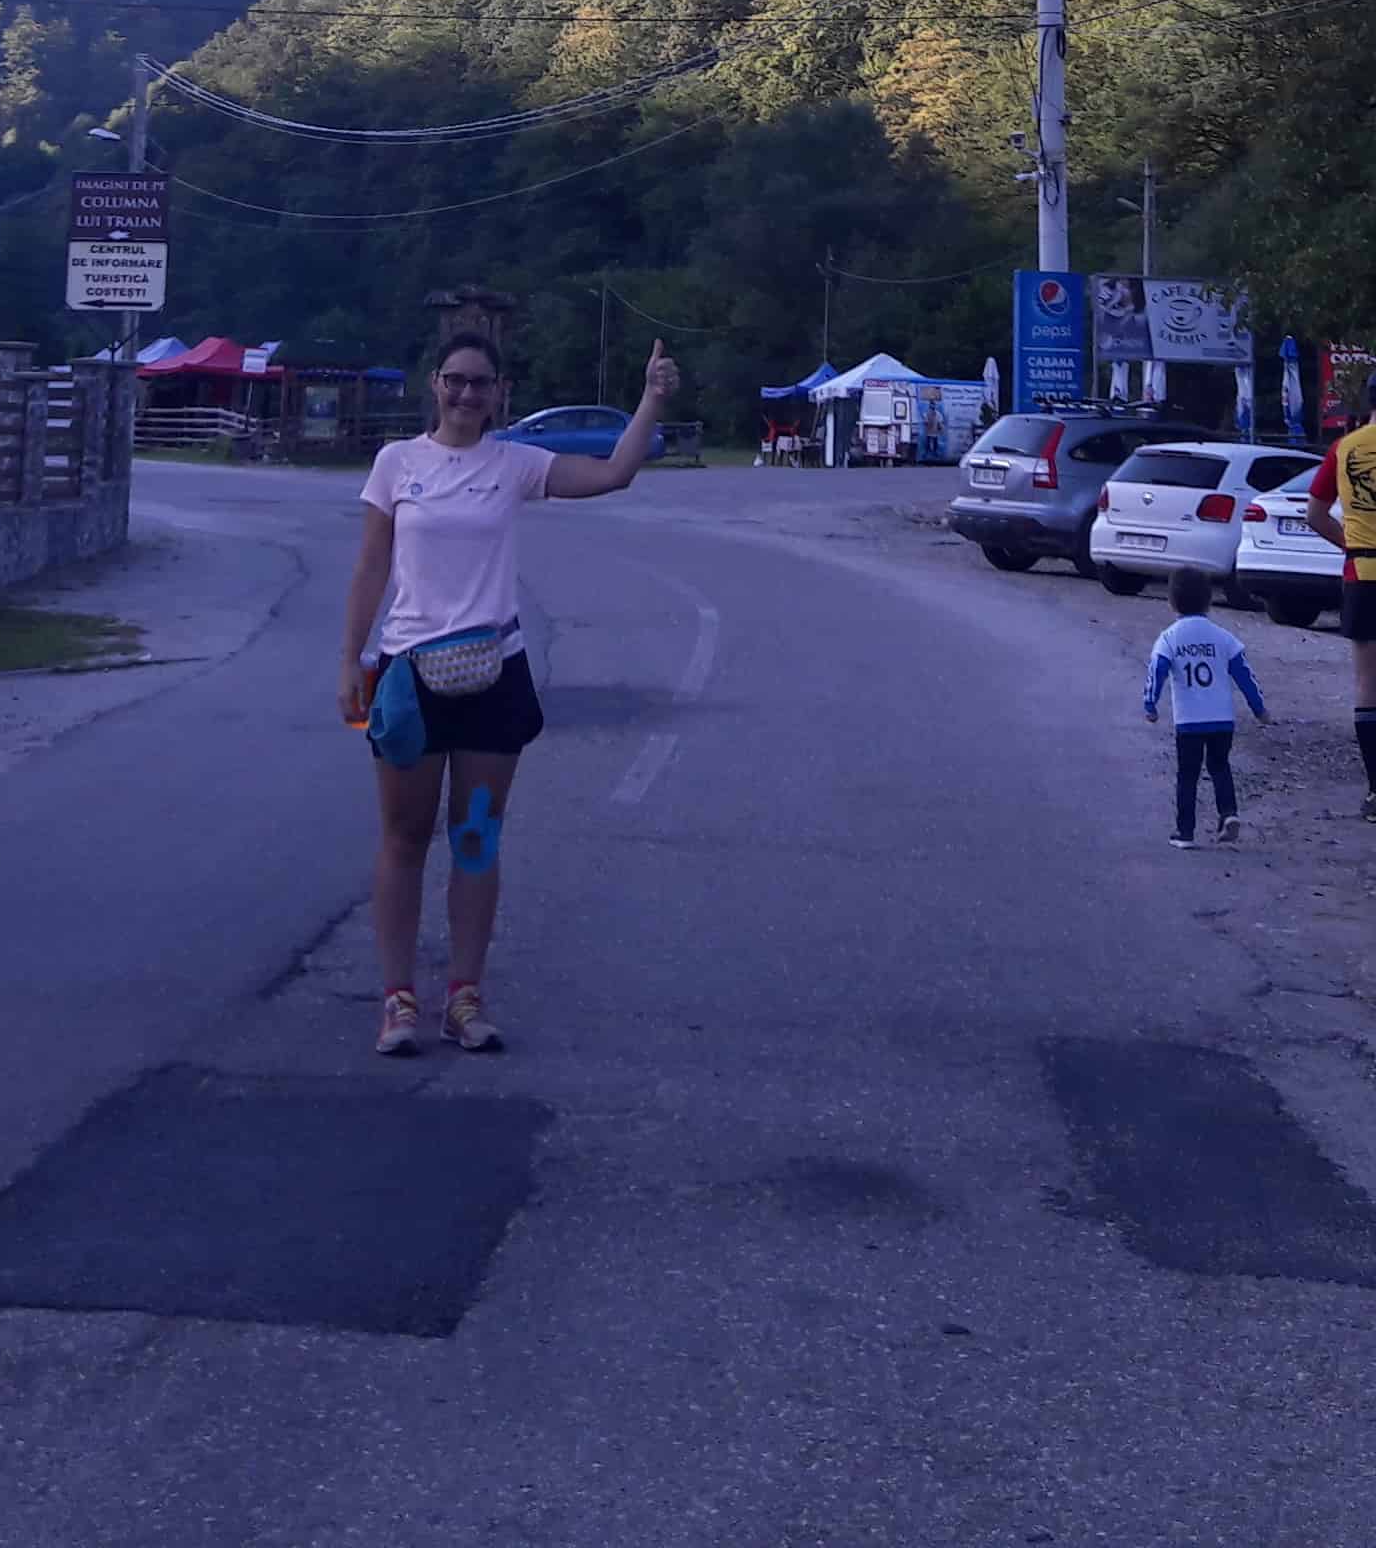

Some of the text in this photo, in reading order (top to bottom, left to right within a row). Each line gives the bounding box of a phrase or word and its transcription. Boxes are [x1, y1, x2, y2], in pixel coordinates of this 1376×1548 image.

[76, 180, 130, 190] IMAGINI
[80, 196, 160, 209] COLUMNA
[76, 215, 162, 228] LUI TRAIAN
[89, 244, 146, 254] CENTRUL
[71, 257, 163, 269] DE INFORMARE
[1032, 323, 1072, 338] pepsi
[1027, 356, 1076, 368] CABANA
[1176, 643, 1216, 658] ANDREI
[1183, 661, 1213, 688] 10
